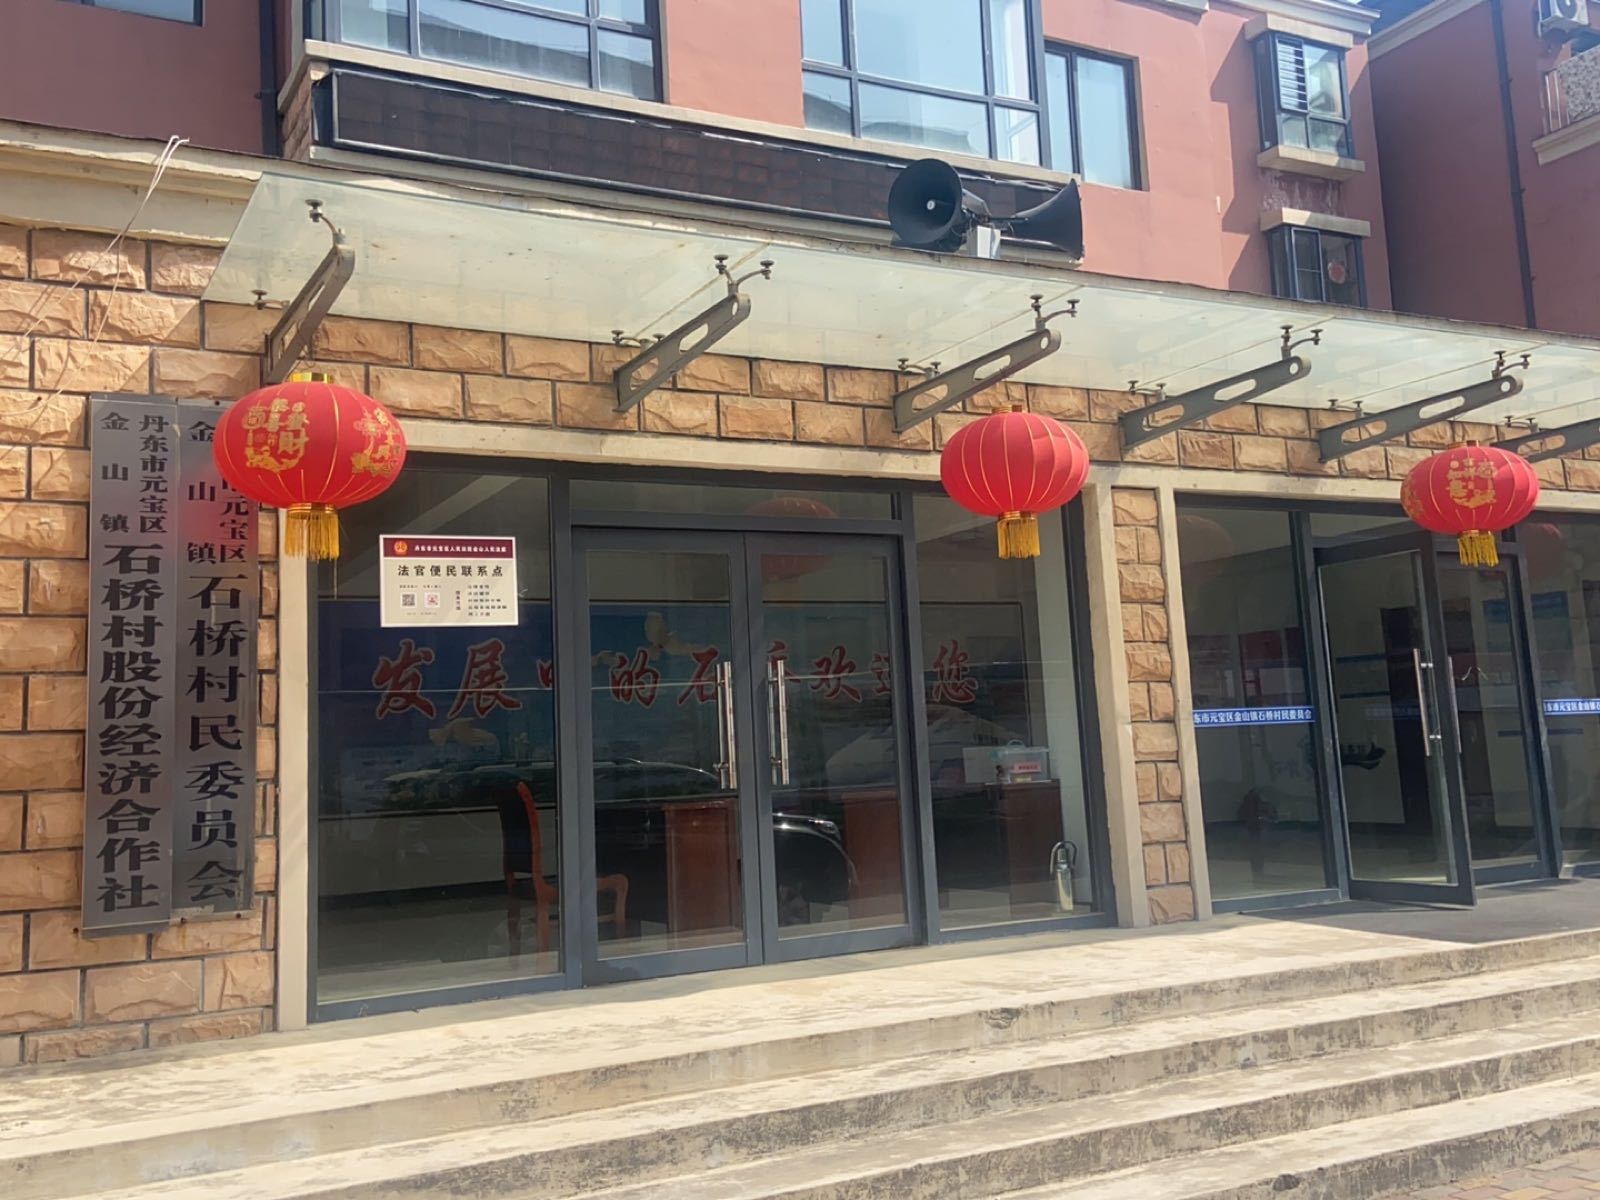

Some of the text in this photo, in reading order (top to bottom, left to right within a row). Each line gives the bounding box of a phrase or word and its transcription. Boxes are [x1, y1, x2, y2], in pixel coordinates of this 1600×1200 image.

[101, 411, 130, 533] 金山镇
[139, 414, 169, 533] 丹东市元宝区
[220, 478, 249, 563] 元宝区
[397, 564, 504, 577] 法官便民联系点
[97, 544, 164, 912] 石桥村股份经济合作社
[185, 574, 249, 902] 石桥村民委员会
